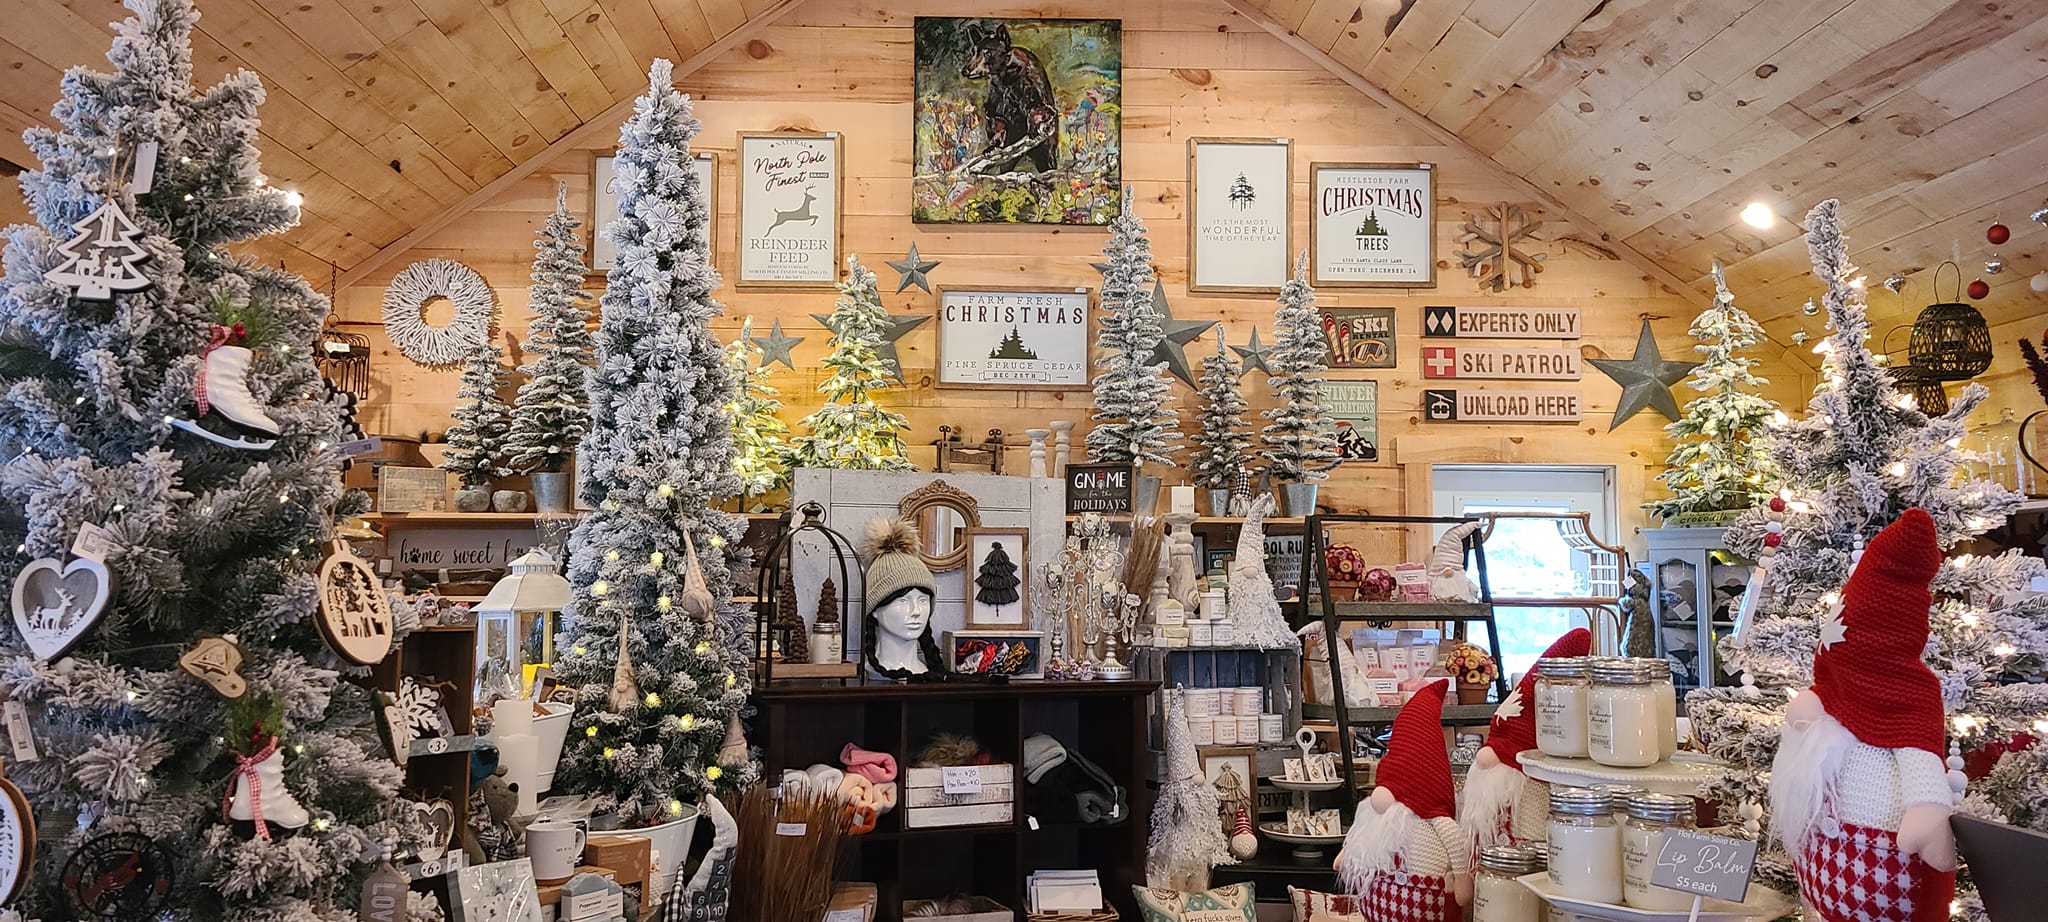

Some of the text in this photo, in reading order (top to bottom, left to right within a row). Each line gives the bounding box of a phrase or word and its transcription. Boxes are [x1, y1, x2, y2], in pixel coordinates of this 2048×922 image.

[754, 151, 827, 174] North Pole
[766, 171, 807, 191] Finest
[1323, 187, 1422, 219] CHRISTMAS
[1202, 226, 1281, 235] WONDERFUL
[751, 239, 828, 250] REINDEER
[1356, 237, 1389, 251] TREES
[770, 252, 809, 263] FEED
[968, 296, 1063, 305] FARM FRESH
[946, 305, 1083, 324] CHRISTMAS
[1353, 317, 1389, 333] SKI
[1459, 313, 1577, 333] EXPERTS ONLY
[1352, 331, 1389, 340] RENTAL
[986, 361, 1033, 370] SPRUCE
[1043, 362, 1082, 371] CEDAR
[1463, 353, 1576, 374] SKI PATROL
[1320, 386, 1374, 401] WINTER
[1463, 396, 1577, 416] UNLOAD HERE
[1073, 499, 1127, 510] HOLIDAYS
[453, 541, 495, 564] sweet
[435, 742, 441, 752] 3
[1692, 832, 1710, 841] Farm
[1711, 835, 1729, 845] Soap
[1657, 836, 1750, 874] Lip Balm
[428, 864, 434, 874] 6
[717, 865, 725, 874] 2
[1675, 876, 1718, 893] $5 each
[698, 896, 705, 905] 6
[696, 908, 703, 919] 9
[712, 906, 723, 916] 10
[1203, 913, 1223, 922] fucks
